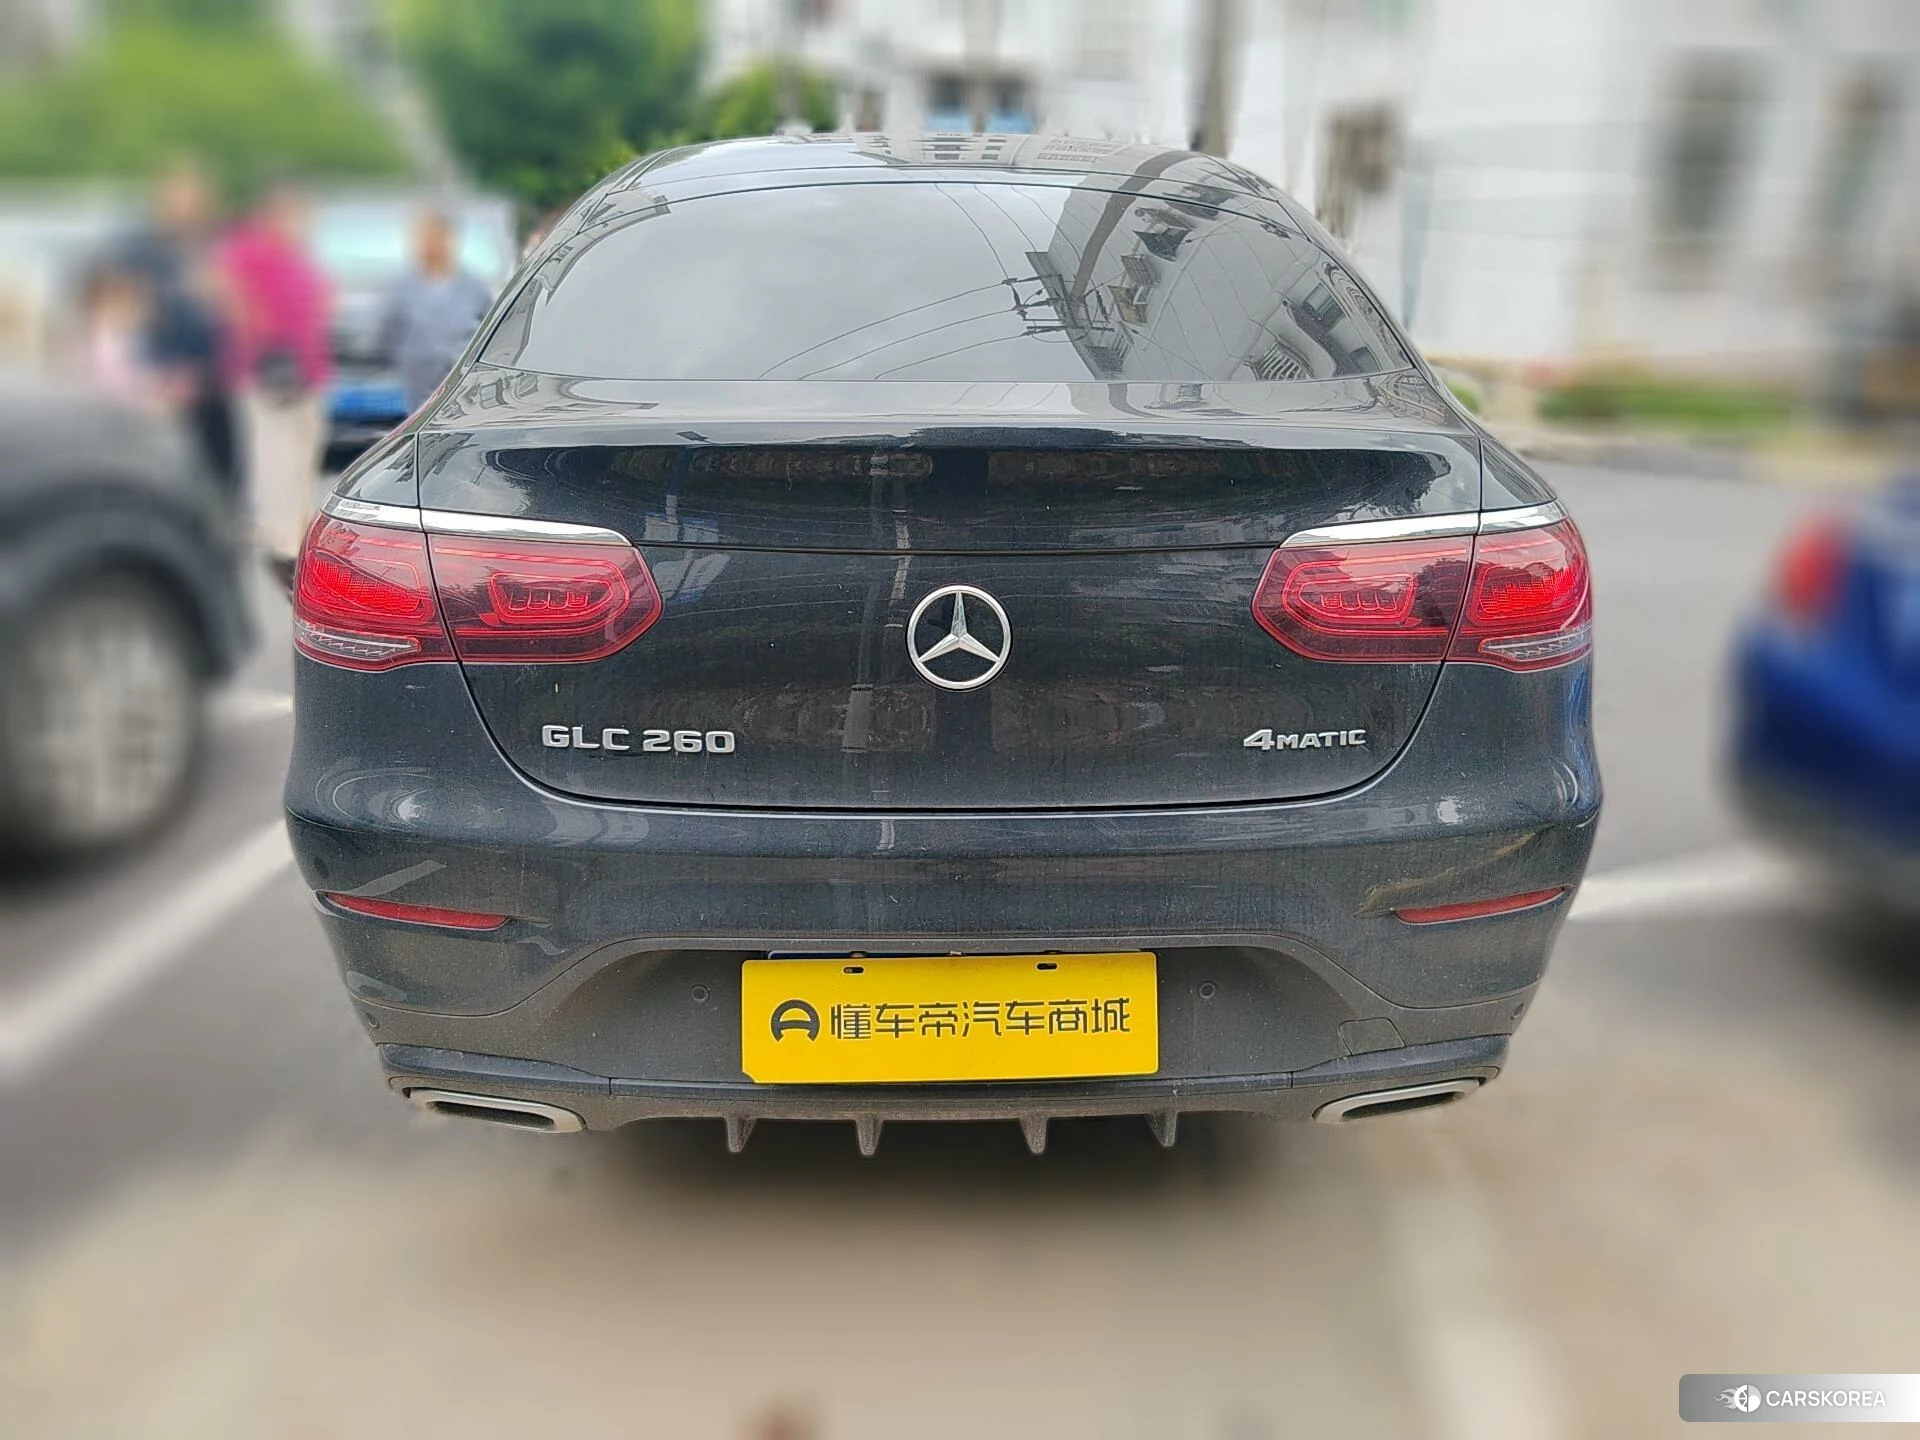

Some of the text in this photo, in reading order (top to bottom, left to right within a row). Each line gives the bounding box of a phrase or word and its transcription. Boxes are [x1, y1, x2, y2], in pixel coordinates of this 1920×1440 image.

[542, 725, 735, 753] GLC 260
[1243, 729, 1366, 750] 4MATIC
[830, 997, 1131, 1040] 懂车帝汽车商城
